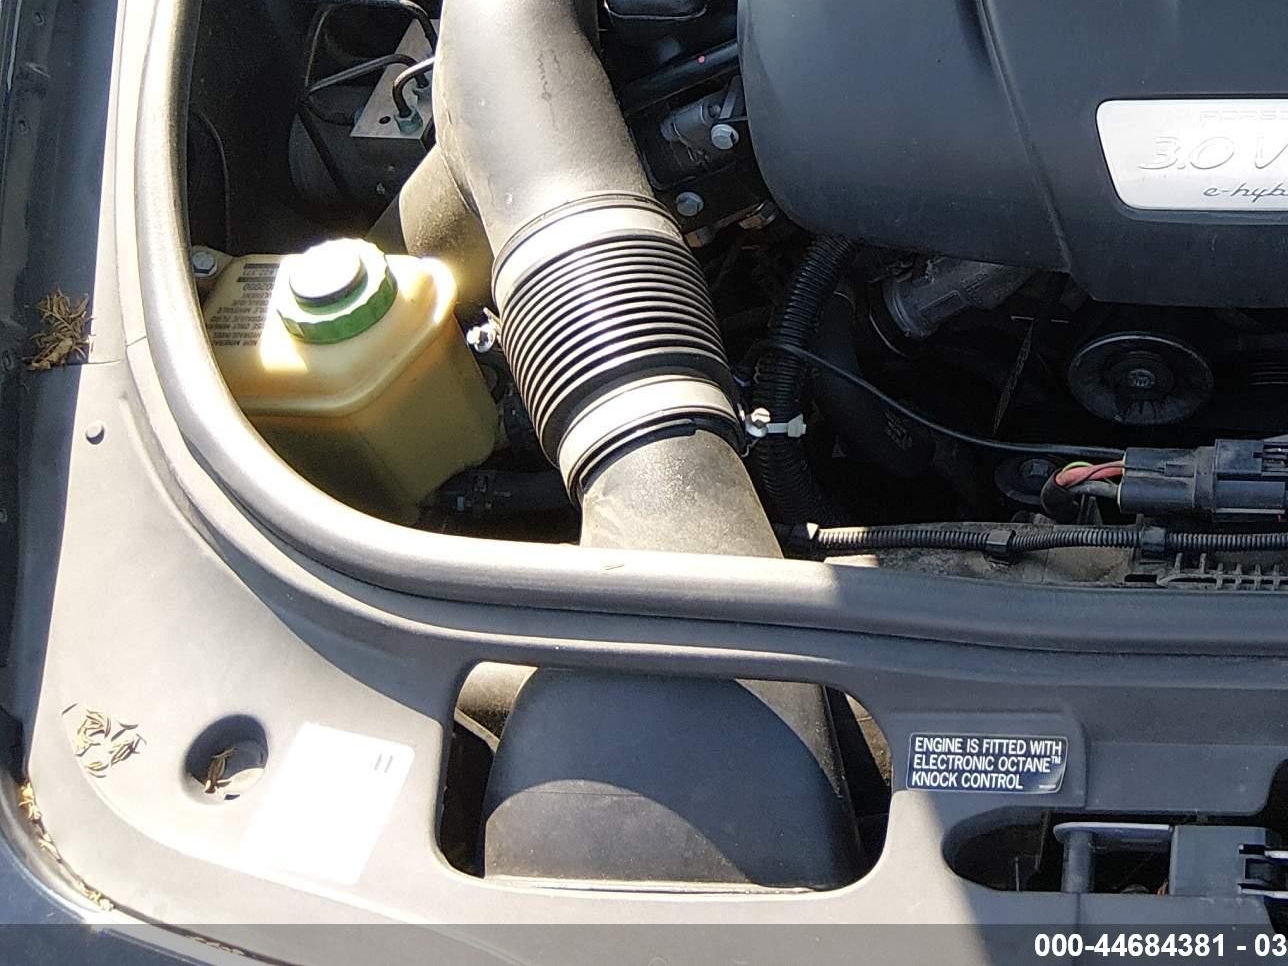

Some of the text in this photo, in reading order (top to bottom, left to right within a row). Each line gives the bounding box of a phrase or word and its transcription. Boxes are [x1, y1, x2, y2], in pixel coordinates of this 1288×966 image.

[1138, 136, 1236, 170] 3.0
[914, 737, 1062, 756] ENGINE IS FITTED WITH
[913, 754, 994, 771] ELECTRONIC
[911, 771, 1024, 789] KNOCK CONTROL
